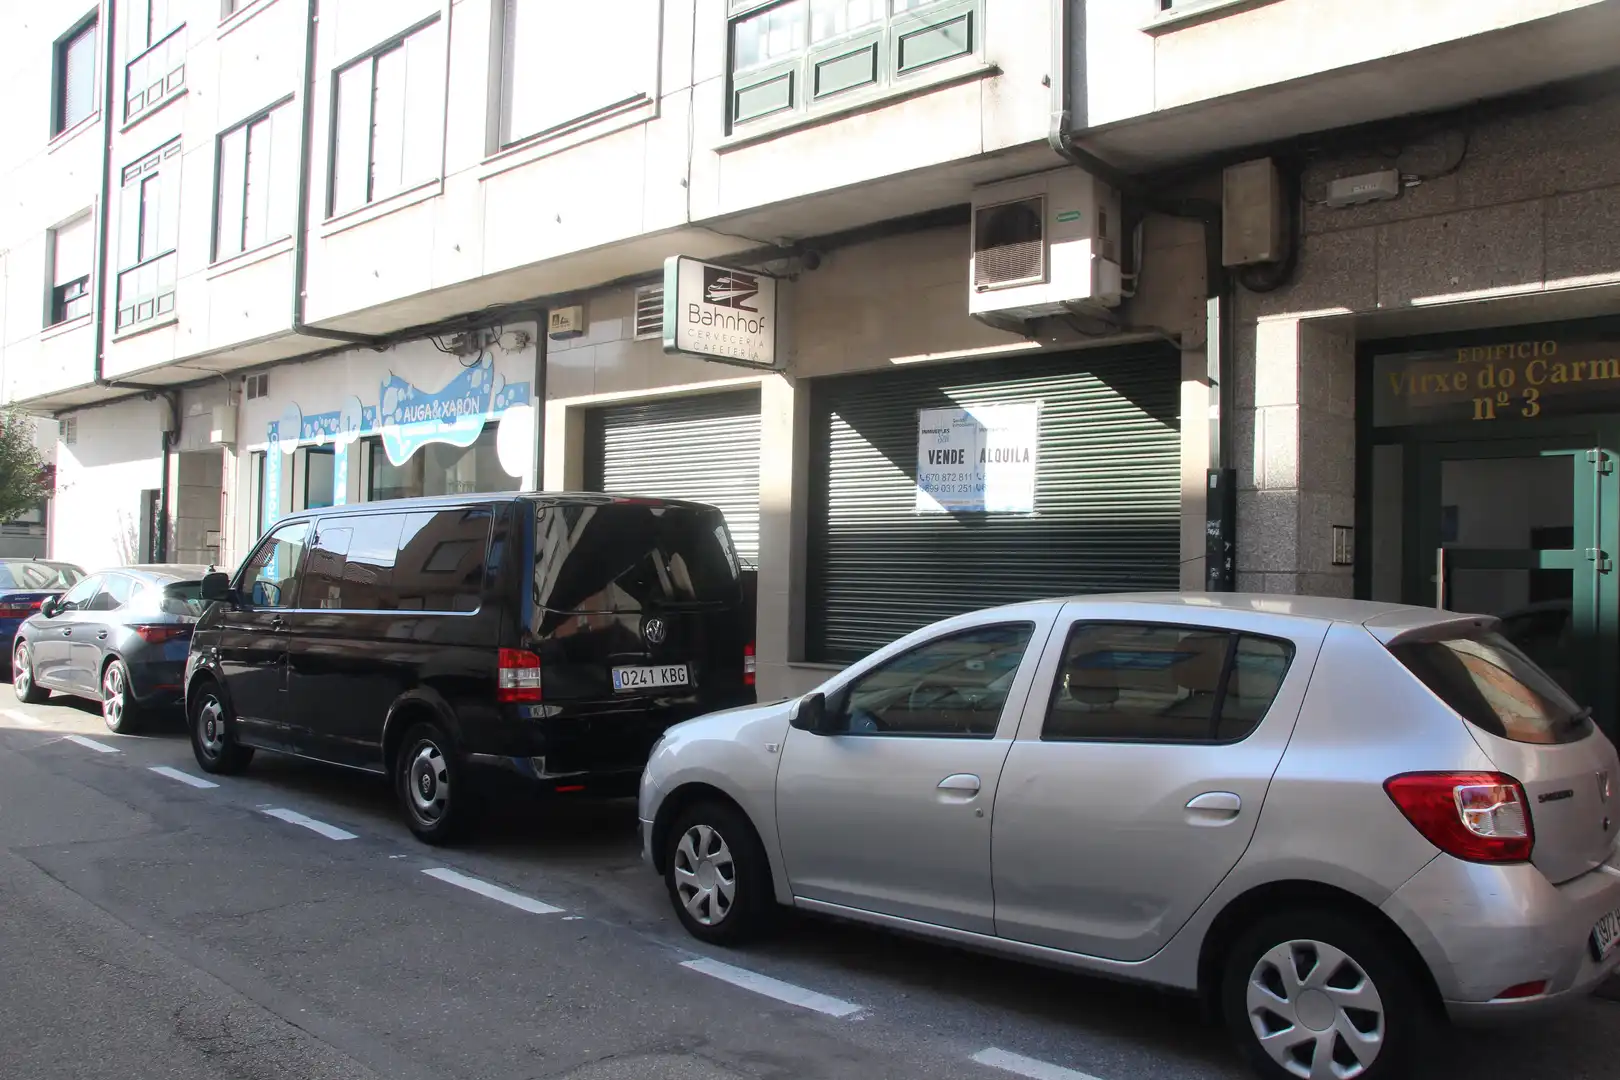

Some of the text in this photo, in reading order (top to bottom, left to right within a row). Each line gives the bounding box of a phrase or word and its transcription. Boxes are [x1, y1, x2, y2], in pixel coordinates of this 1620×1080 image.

[689, 304, 765, 334] Bahnhof
[1456, 340, 1557, 364] EDIFICIO
[1388, 370, 1468, 396] Virxe
[1478, 365, 1516, 389] do
[1521, 387, 1541, 418] 3
[928, 449, 965, 465] VENDE
[979, 447, 1030, 464] ALQUILA
[925, 473, 940, 482] 670
[941, 473, 957, 482] 872
[958, 473, 973, 481] 811
[940, 484, 955, 493] 031
[957, 484, 972, 493] 251
[621, 667, 686, 685] 0241 KBG
